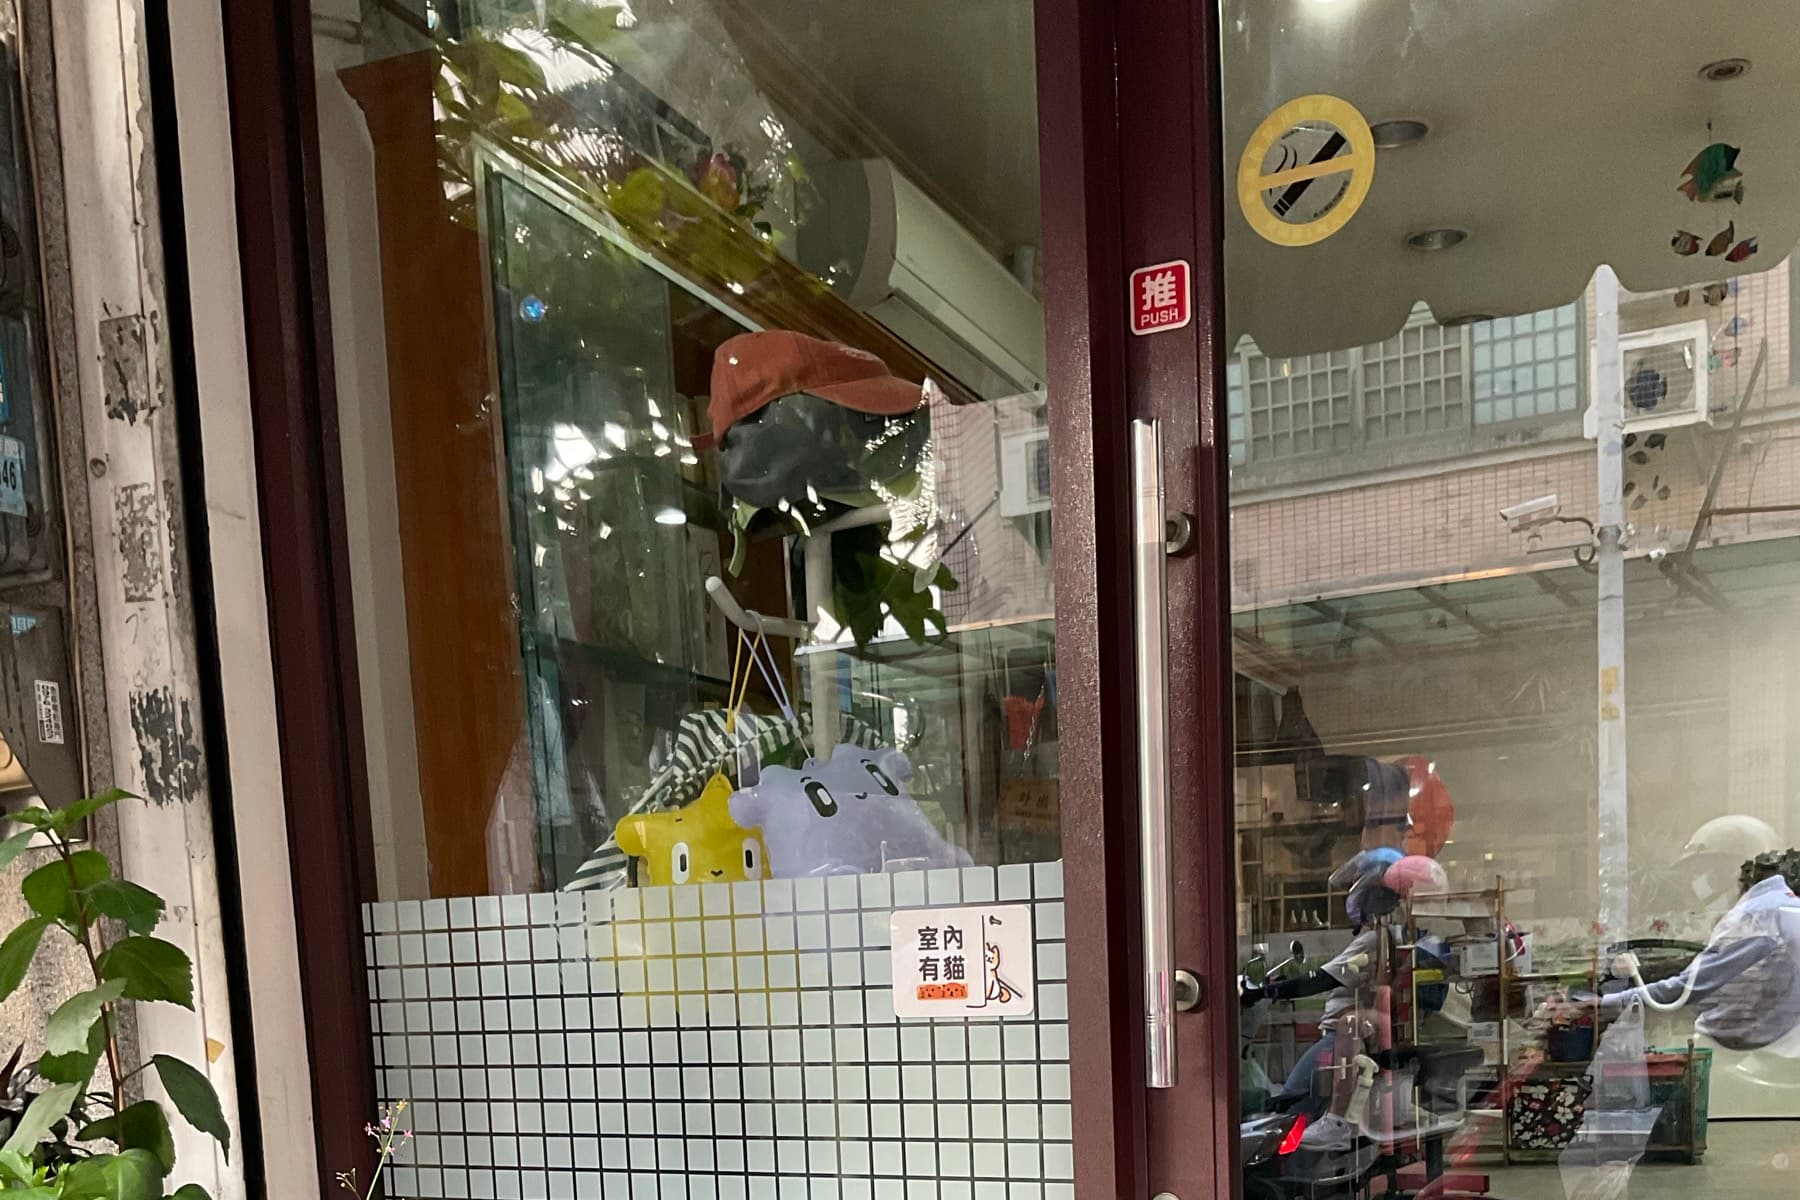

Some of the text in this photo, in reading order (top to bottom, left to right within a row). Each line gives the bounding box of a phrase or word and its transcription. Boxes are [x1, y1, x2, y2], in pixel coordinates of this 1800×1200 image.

[1141, 270, 1177, 311] 推
[1140, 307, 1179, 327] PUSH
[0, 459, 17, 491] 46
[917, 925, 963, 951] 室內
[918, 955, 965, 982] 有貓
